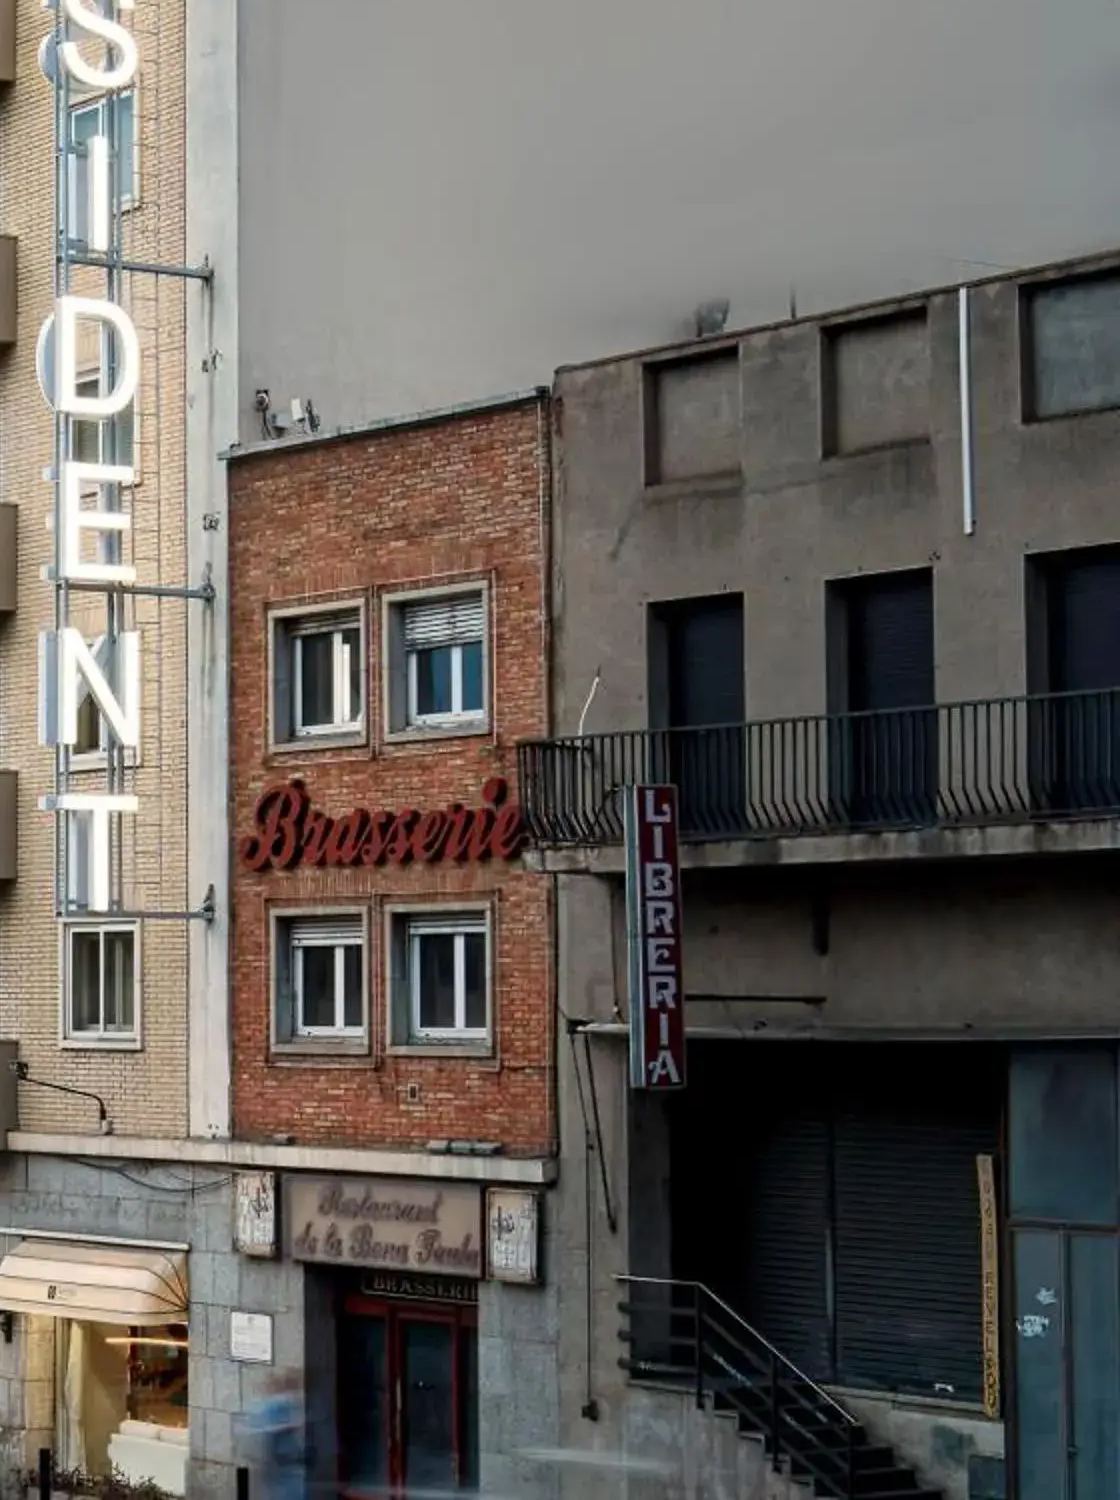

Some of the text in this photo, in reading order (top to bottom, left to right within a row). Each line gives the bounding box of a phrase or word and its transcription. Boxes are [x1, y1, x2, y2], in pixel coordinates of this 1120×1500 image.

[240, 778, 528, 872] Brasserie
[644, 789, 681, 1084] LIBRERIA
[317, 1181, 443, 1223] Restaurant
